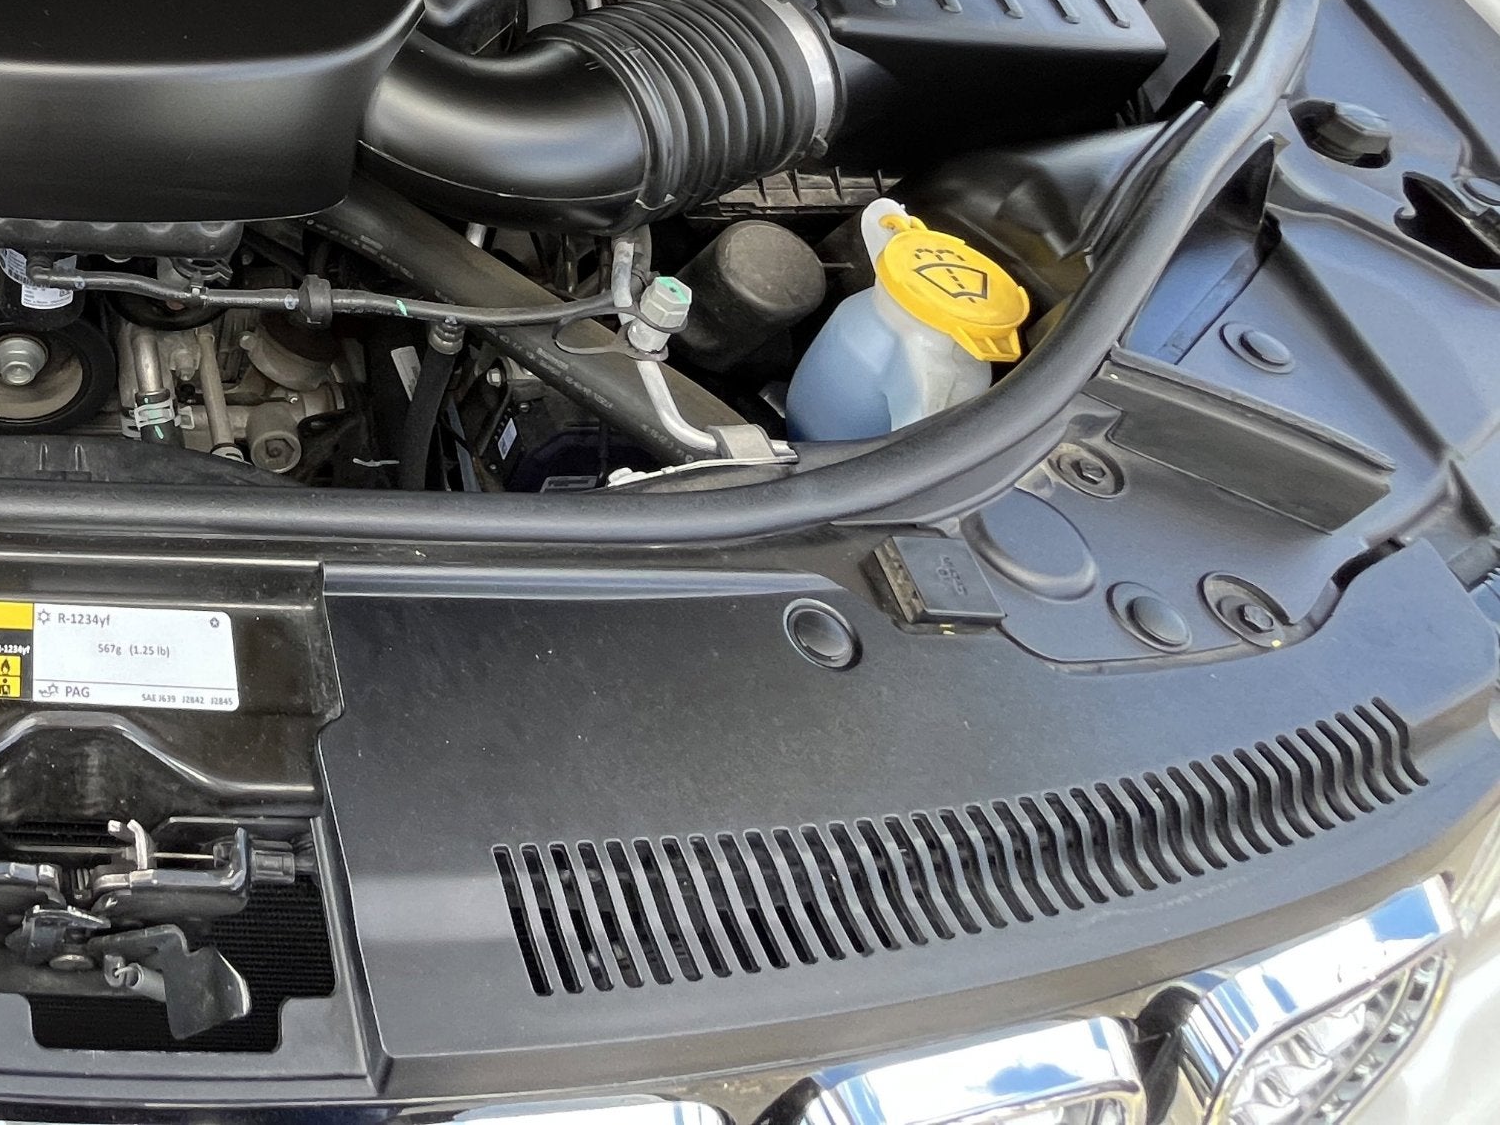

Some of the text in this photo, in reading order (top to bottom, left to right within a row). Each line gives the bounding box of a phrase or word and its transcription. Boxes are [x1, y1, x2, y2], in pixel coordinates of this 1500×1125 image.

[57, 612, 111, 628] R-1234yf
[97, 643, 170, 659] 567g (1.25 lb)
[65, 685, 90, 698] PAG
[141, 693, 156, 702] SAE
